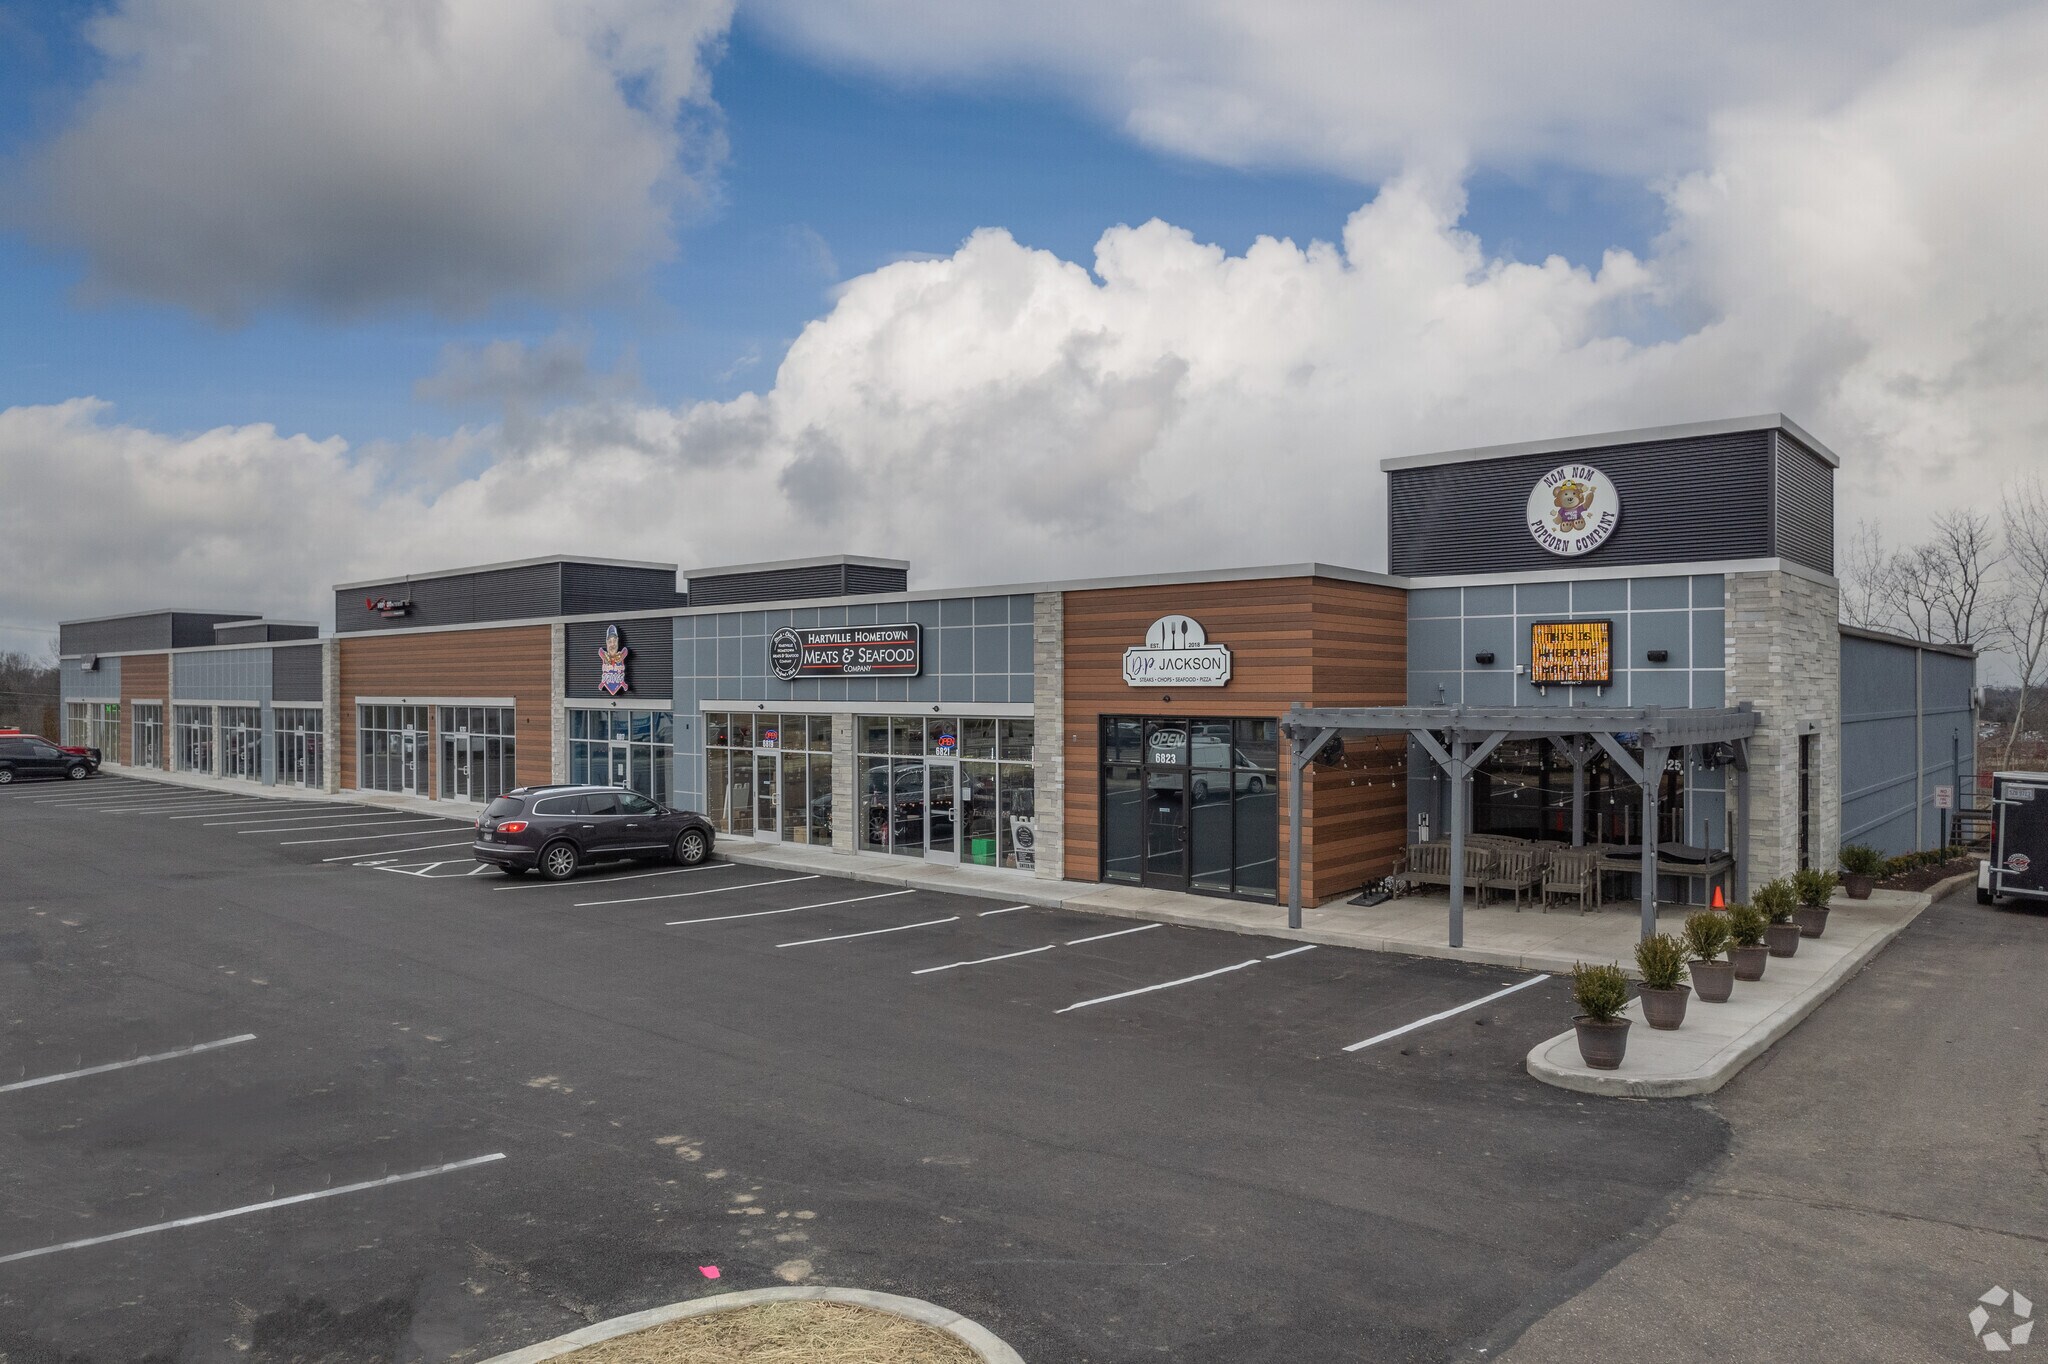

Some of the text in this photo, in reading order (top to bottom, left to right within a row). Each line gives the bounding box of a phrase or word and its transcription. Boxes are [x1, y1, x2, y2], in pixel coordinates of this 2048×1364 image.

[1543, 467, 1595, 488] NOM NOM
[1531, 511, 1615, 552] POPCORN COMPANY
[808, 630, 909, 644] HARTVILLE HOMETOWN
[803, 647, 915, 664] MEATS & SEAFOOD
[843, 664, 872, 673] COMPANY
[1159, 657, 1221, 670] JACKSON
[1151, 732, 1185, 746] OPEN
[935, 746, 950, 756] 6821
[1155, 753, 1177, 764] 6823
